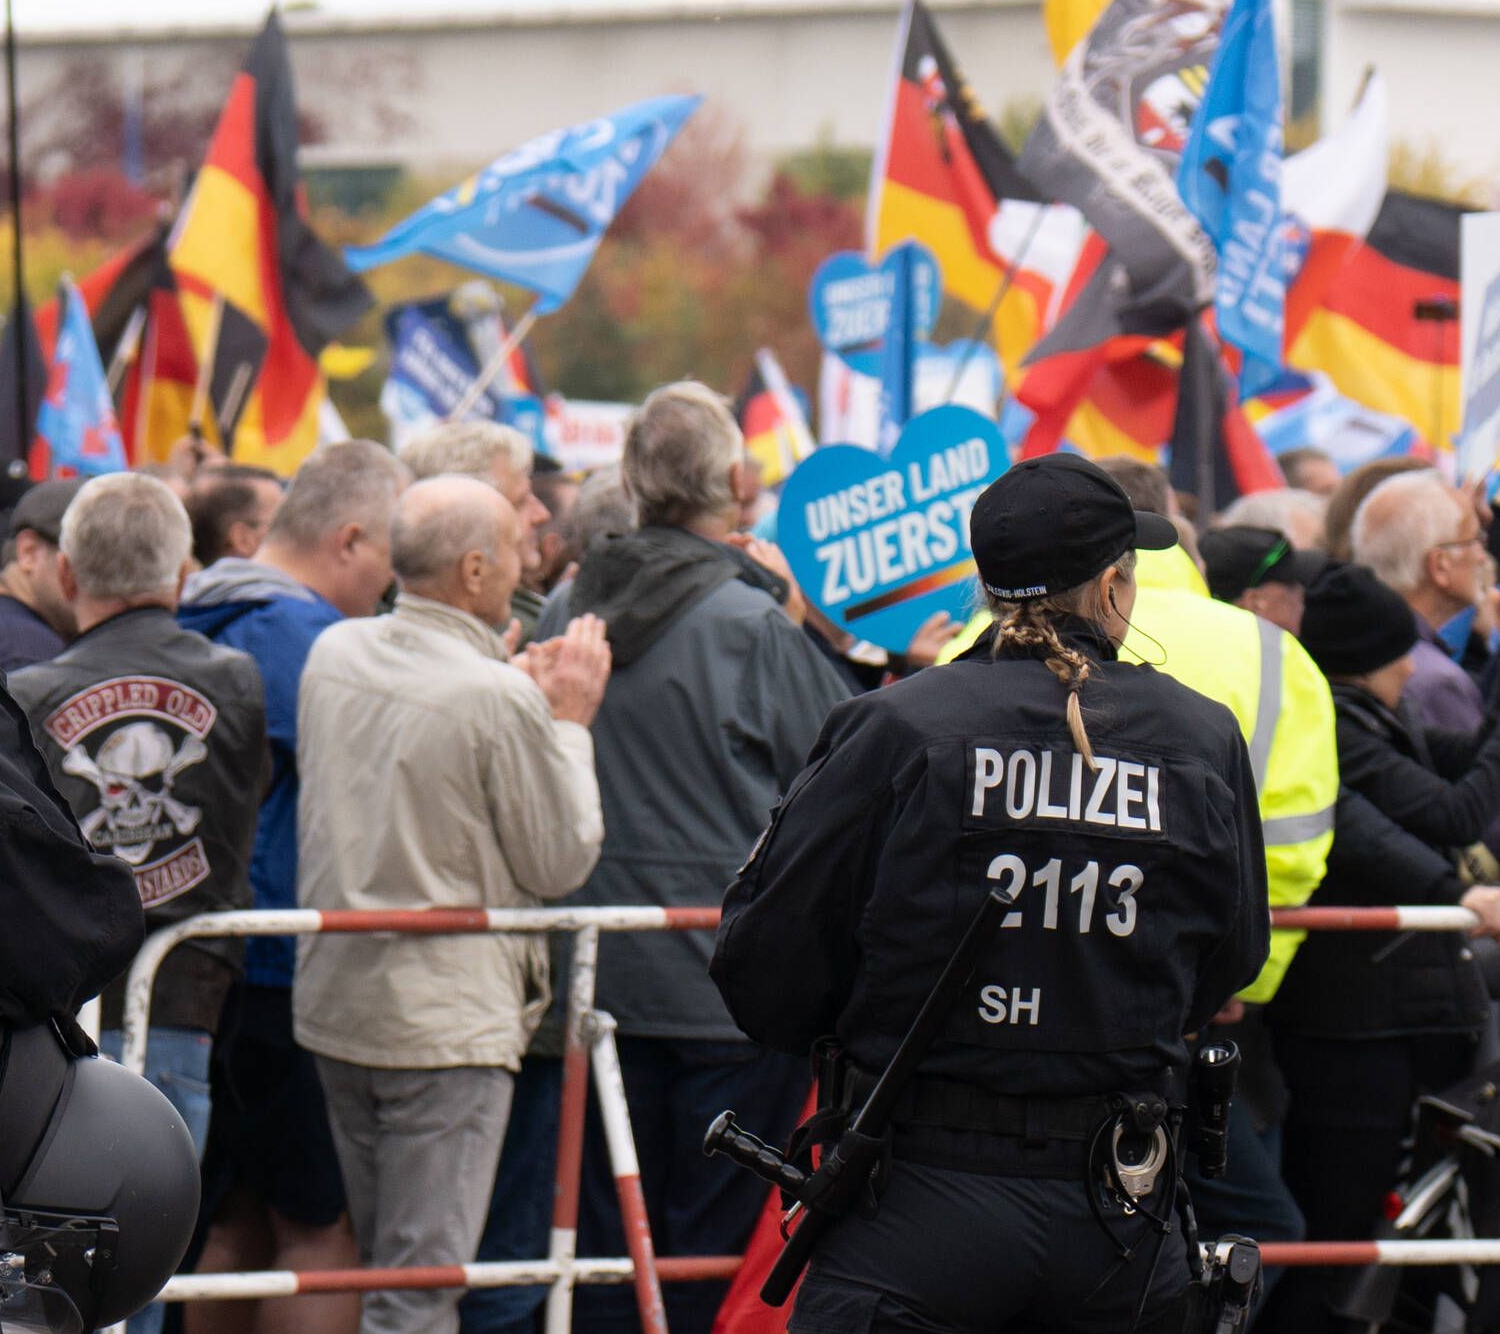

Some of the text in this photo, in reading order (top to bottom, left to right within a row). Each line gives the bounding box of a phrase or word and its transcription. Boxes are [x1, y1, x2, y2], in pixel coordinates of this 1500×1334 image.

[805, 437, 990, 542] UNSER LAND
[52, 683, 209, 740] CRIPPLED OLD
[972, 747, 1161, 831] POLIZEI
[986, 854, 1144, 937] 2113
[978, 985, 1041, 1026] SH
